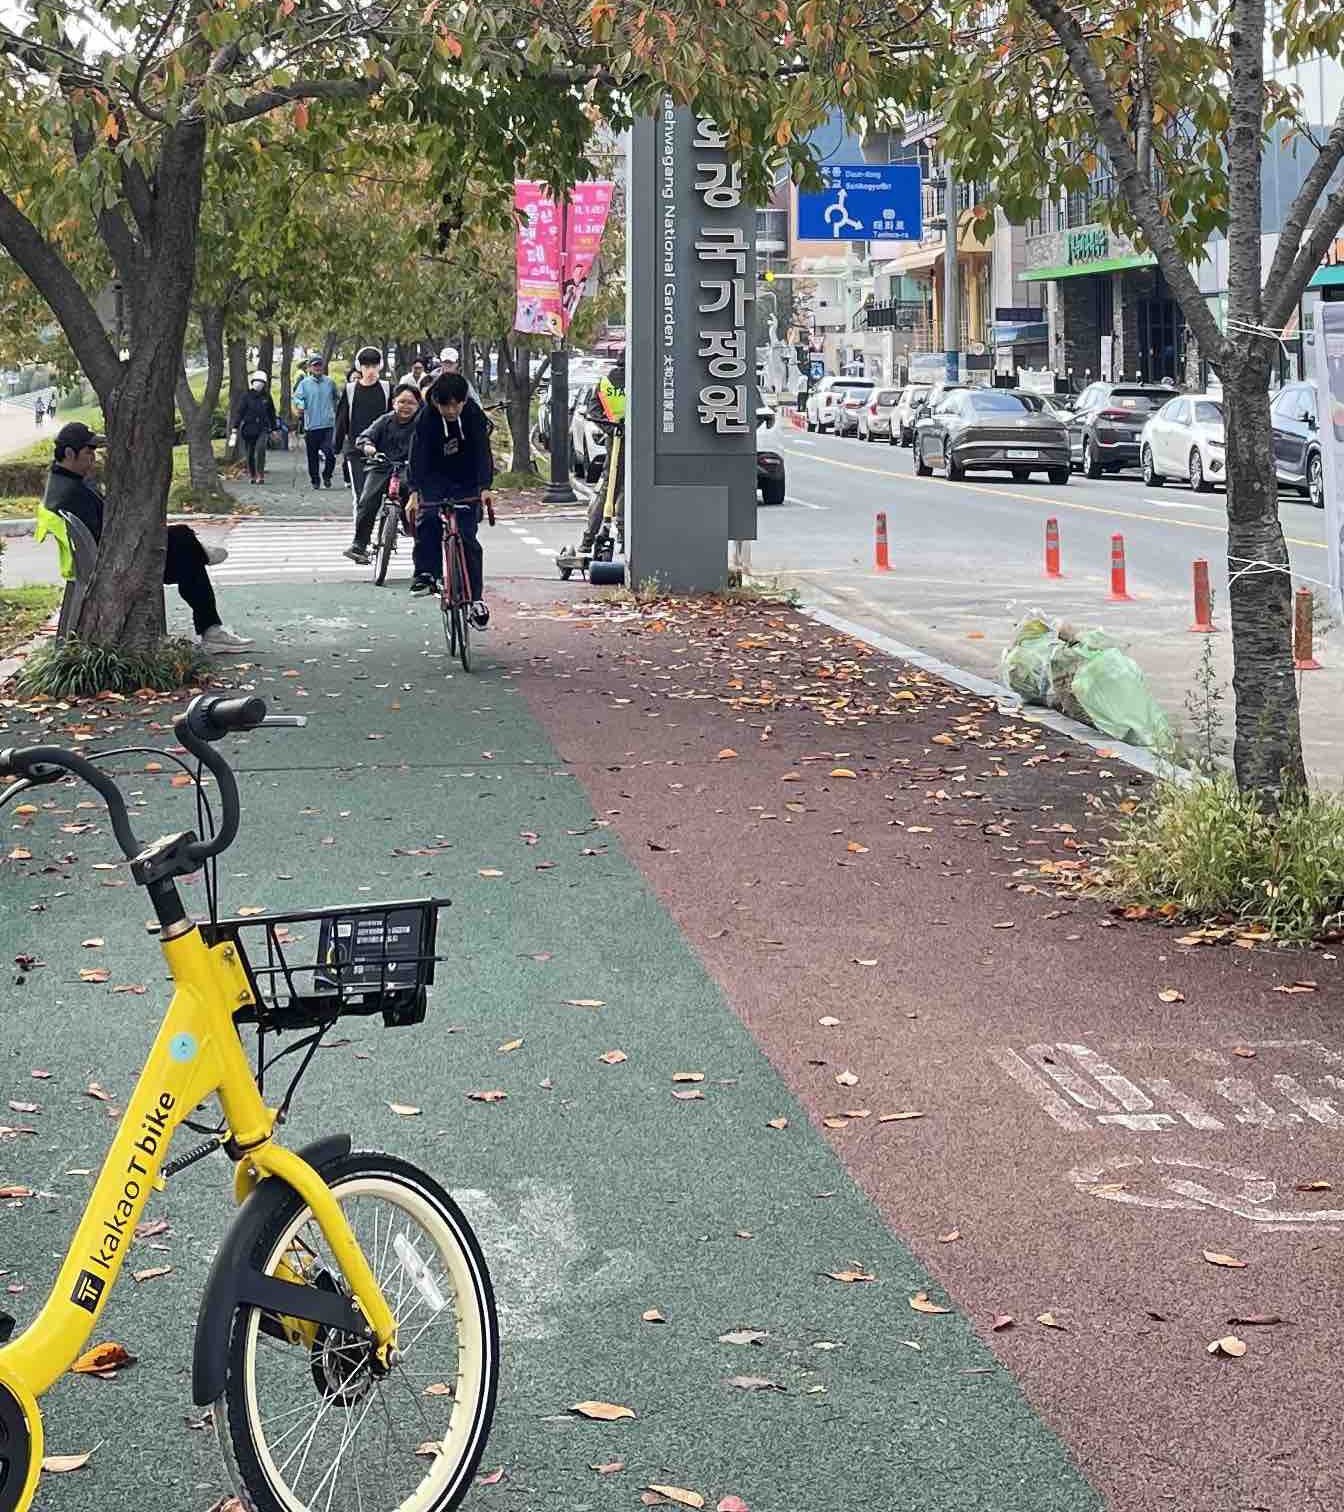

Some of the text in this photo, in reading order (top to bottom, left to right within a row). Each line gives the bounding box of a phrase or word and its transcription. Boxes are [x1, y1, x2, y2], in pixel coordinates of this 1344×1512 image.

[662, 205, 676, 278] National
[662, 283, 676, 347] Garden
[693, 228, 756, 433] 국가정원
[89, 1091, 176, 1270] kakao T bike
